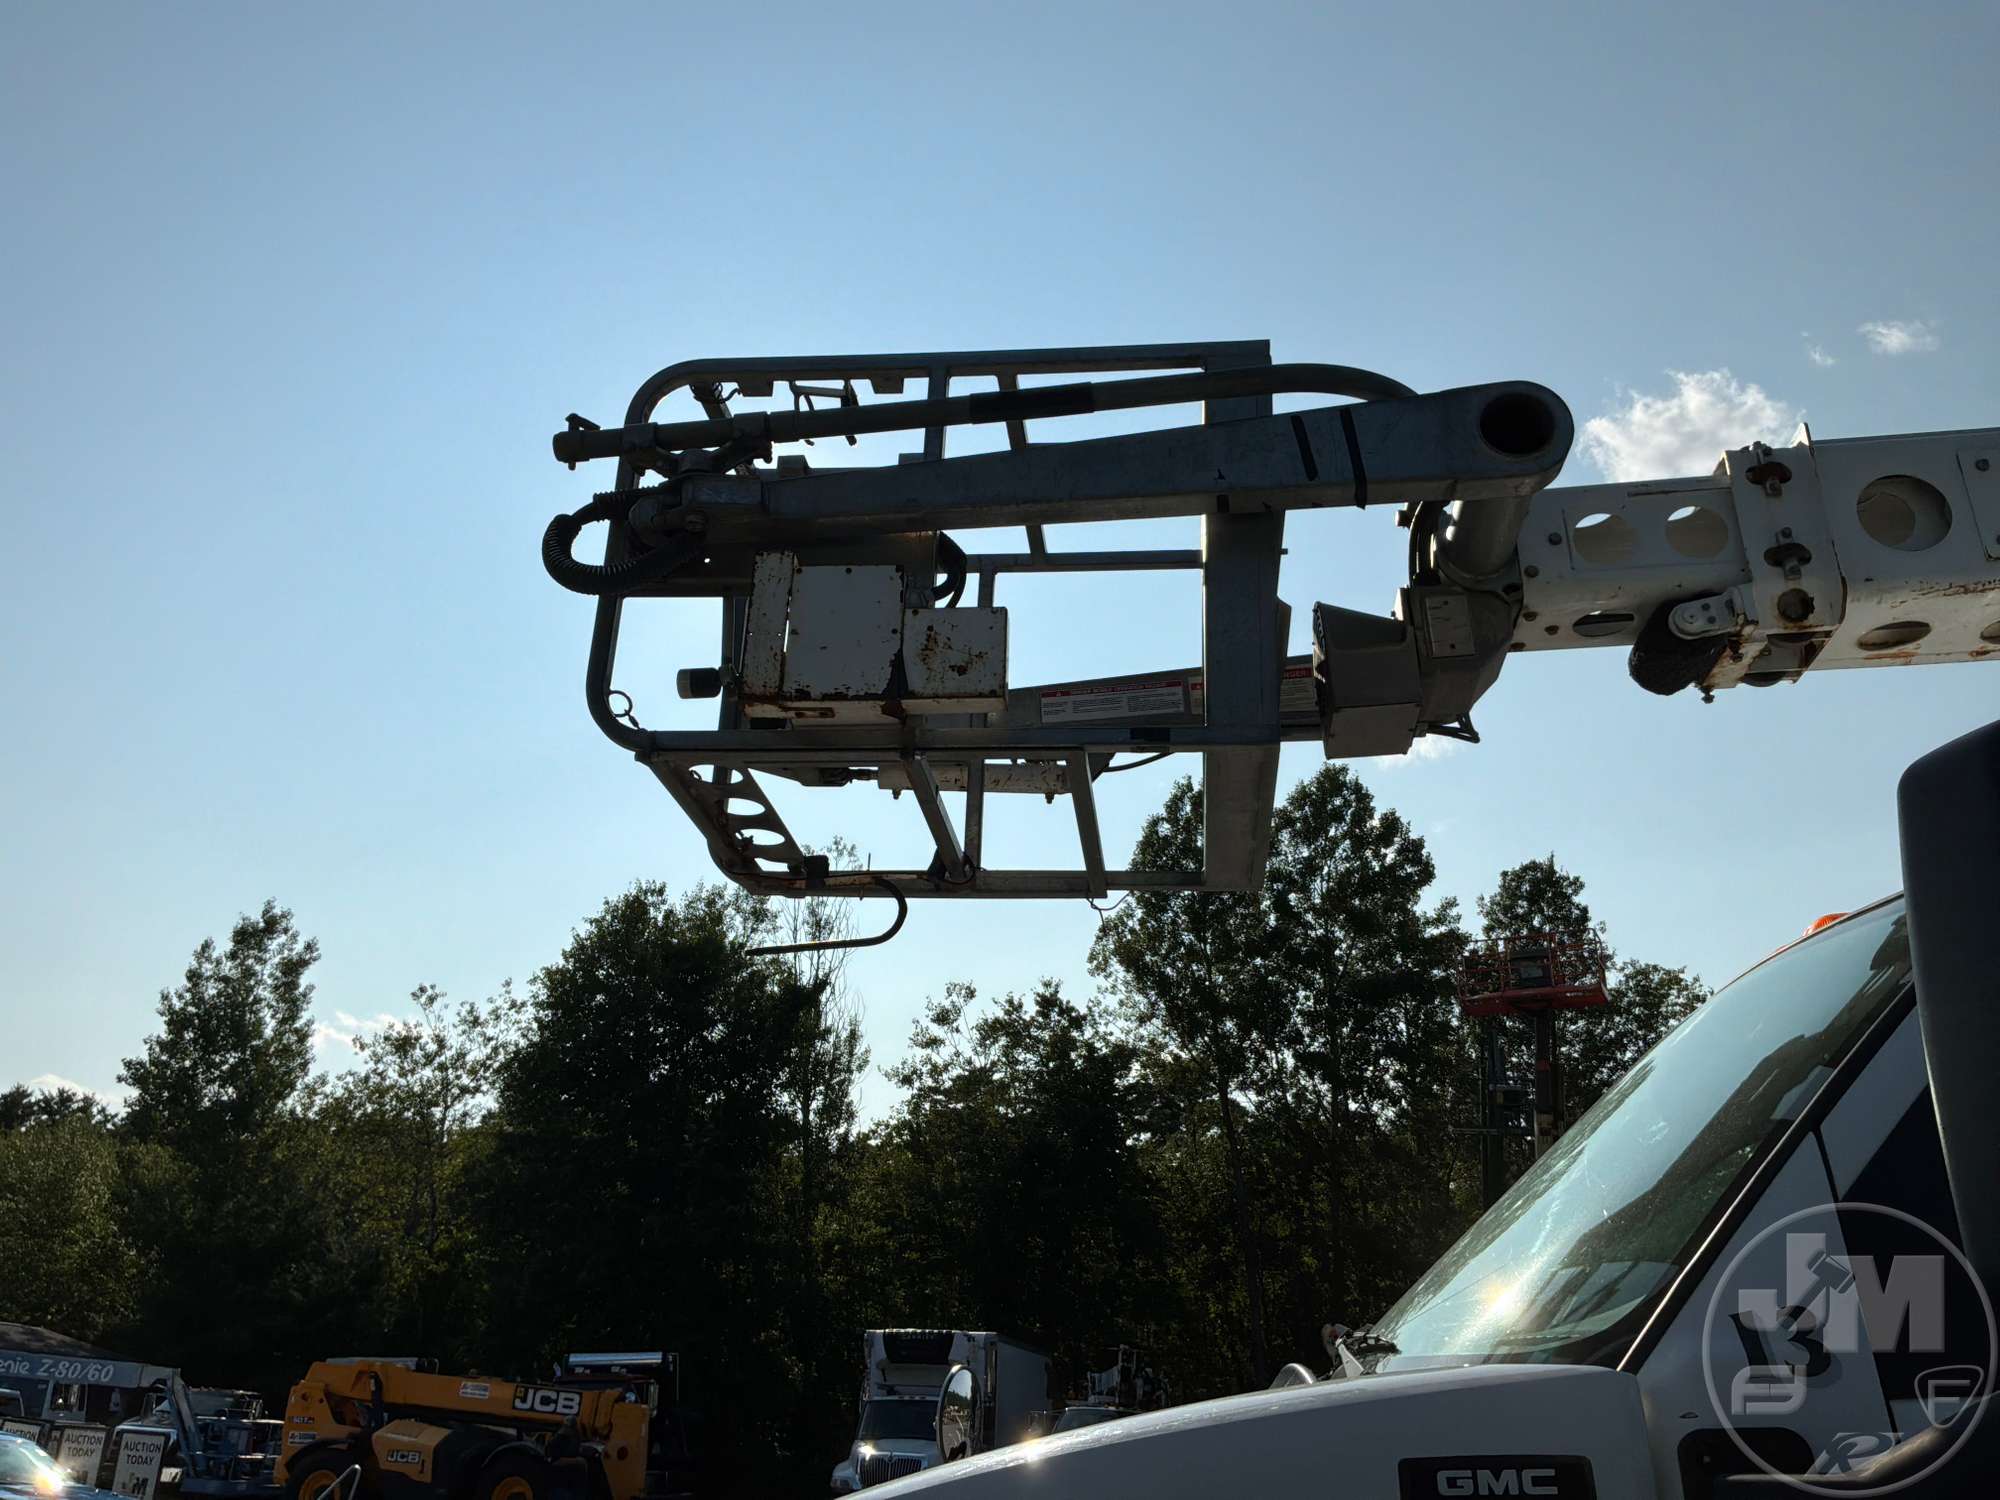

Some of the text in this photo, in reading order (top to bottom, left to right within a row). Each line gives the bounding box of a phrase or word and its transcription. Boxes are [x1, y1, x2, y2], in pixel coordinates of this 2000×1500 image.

[36, 1359, 115, 1382] Z-80/60
[513, 1387, 581, 1415] JCB
[64, 1431, 103, 1446] AUCTION
[67, 1446, 96, 1457] TODAY
[123, 1440, 162, 1453] AUCTION
[126, 1454, 154, 1466] TODAY
[388, 1449, 421, 1463] JCB
[1436, 1468, 1559, 1497] GMC
